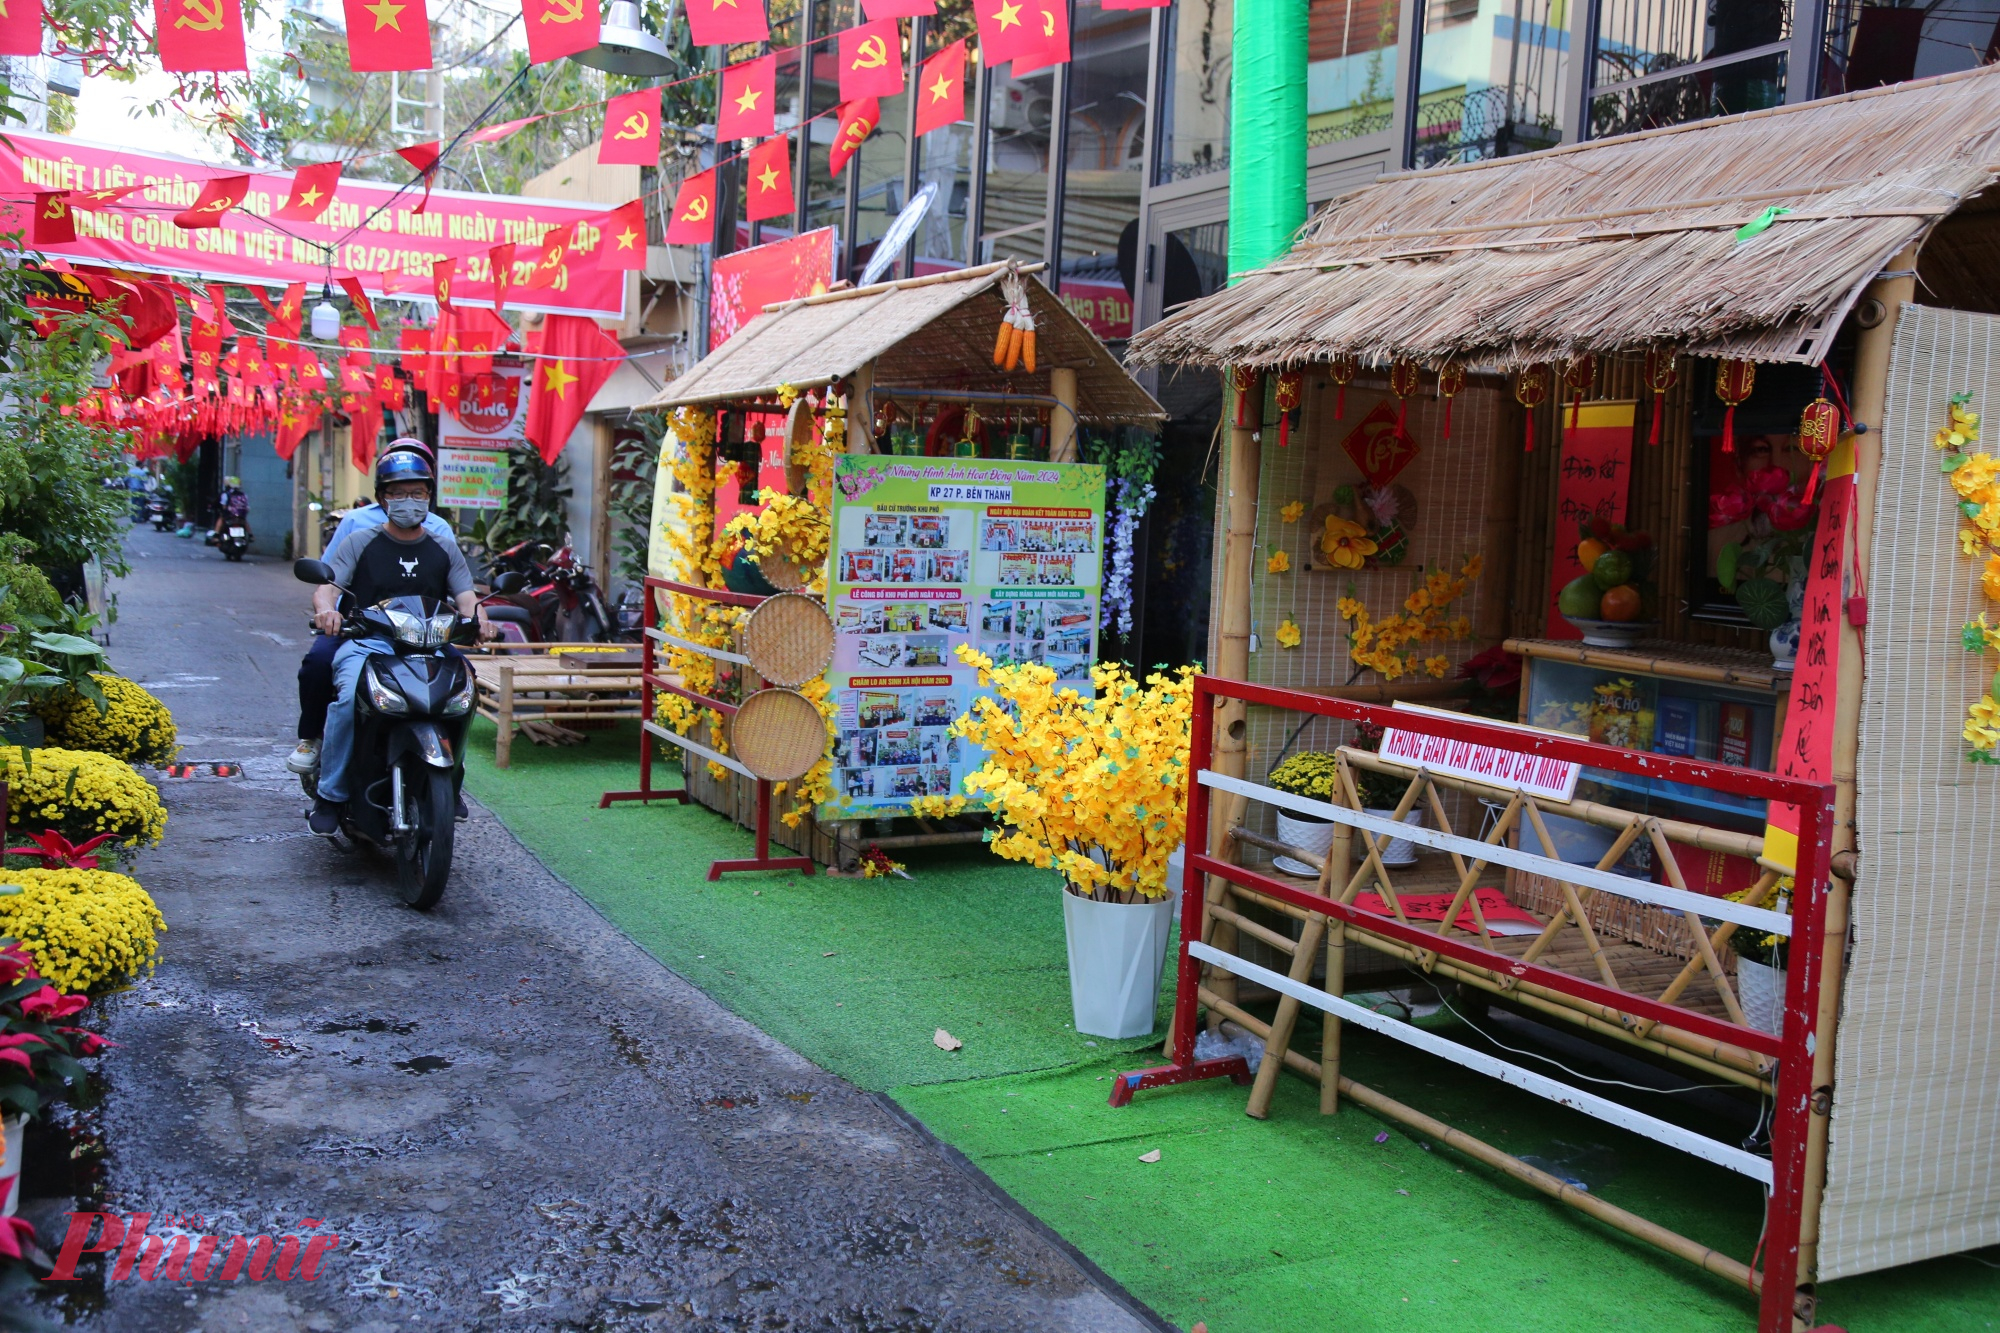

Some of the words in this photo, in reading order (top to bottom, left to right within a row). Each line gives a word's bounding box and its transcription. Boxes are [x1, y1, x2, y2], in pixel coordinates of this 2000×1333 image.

[143, 173, 200, 208] CHÀO
[366, 205, 392, 233] 96
[449, 211, 497, 243] NGÀY
[131, 213, 189, 252] CỘNG
[243, 228, 286, 266] VIỆT
[292, 237, 339, 268] NAM
[891, 464, 920, 480] Những
[922, 466, 944, 480] Hình
[947, 464, 964, 480] Ảnh
[967, 469, 988, 482] Hoạt
[989, 468, 1012, 483] Động
[1014, 470, 1035, 481] Năm
[1037, 470, 1060, 483] 2024
[930, 487, 941, 498] KP
[944, 487, 953, 498] 27
[956, 487, 964, 499] P.
[966, 485, 983, 500] BẾN
[985, 486, 1011, 500] THÀNH
[918, 505, 928, 513] KHU
[929, 504, 940, 513] PHỐ
[860, 590, 876, 598] CÔNG
[876, 589, 885, 598] BỐ
[885, 591, 896, 599] KHU
[897, 589, 908, 598] PHỐ
[909, 590, 920, 598] MỚI
[920, 590, 934, 598] NGÀY
[946, 591, 959, 599] 2024
[1034, 590, 1047, 598] XANH
[852, 678, 869, 686] CHĂM
[870, 678, 878, 686] LO
[879, 678, 887, 686] AN
[903, 677, 911, 685] XÃ
[911, 677, 921, 686] HỘI
[921, 677, 934, 685] NĂM
[1675, 742, 1685, 750] NAM
[1535, 756, 1570, 791] MINH
